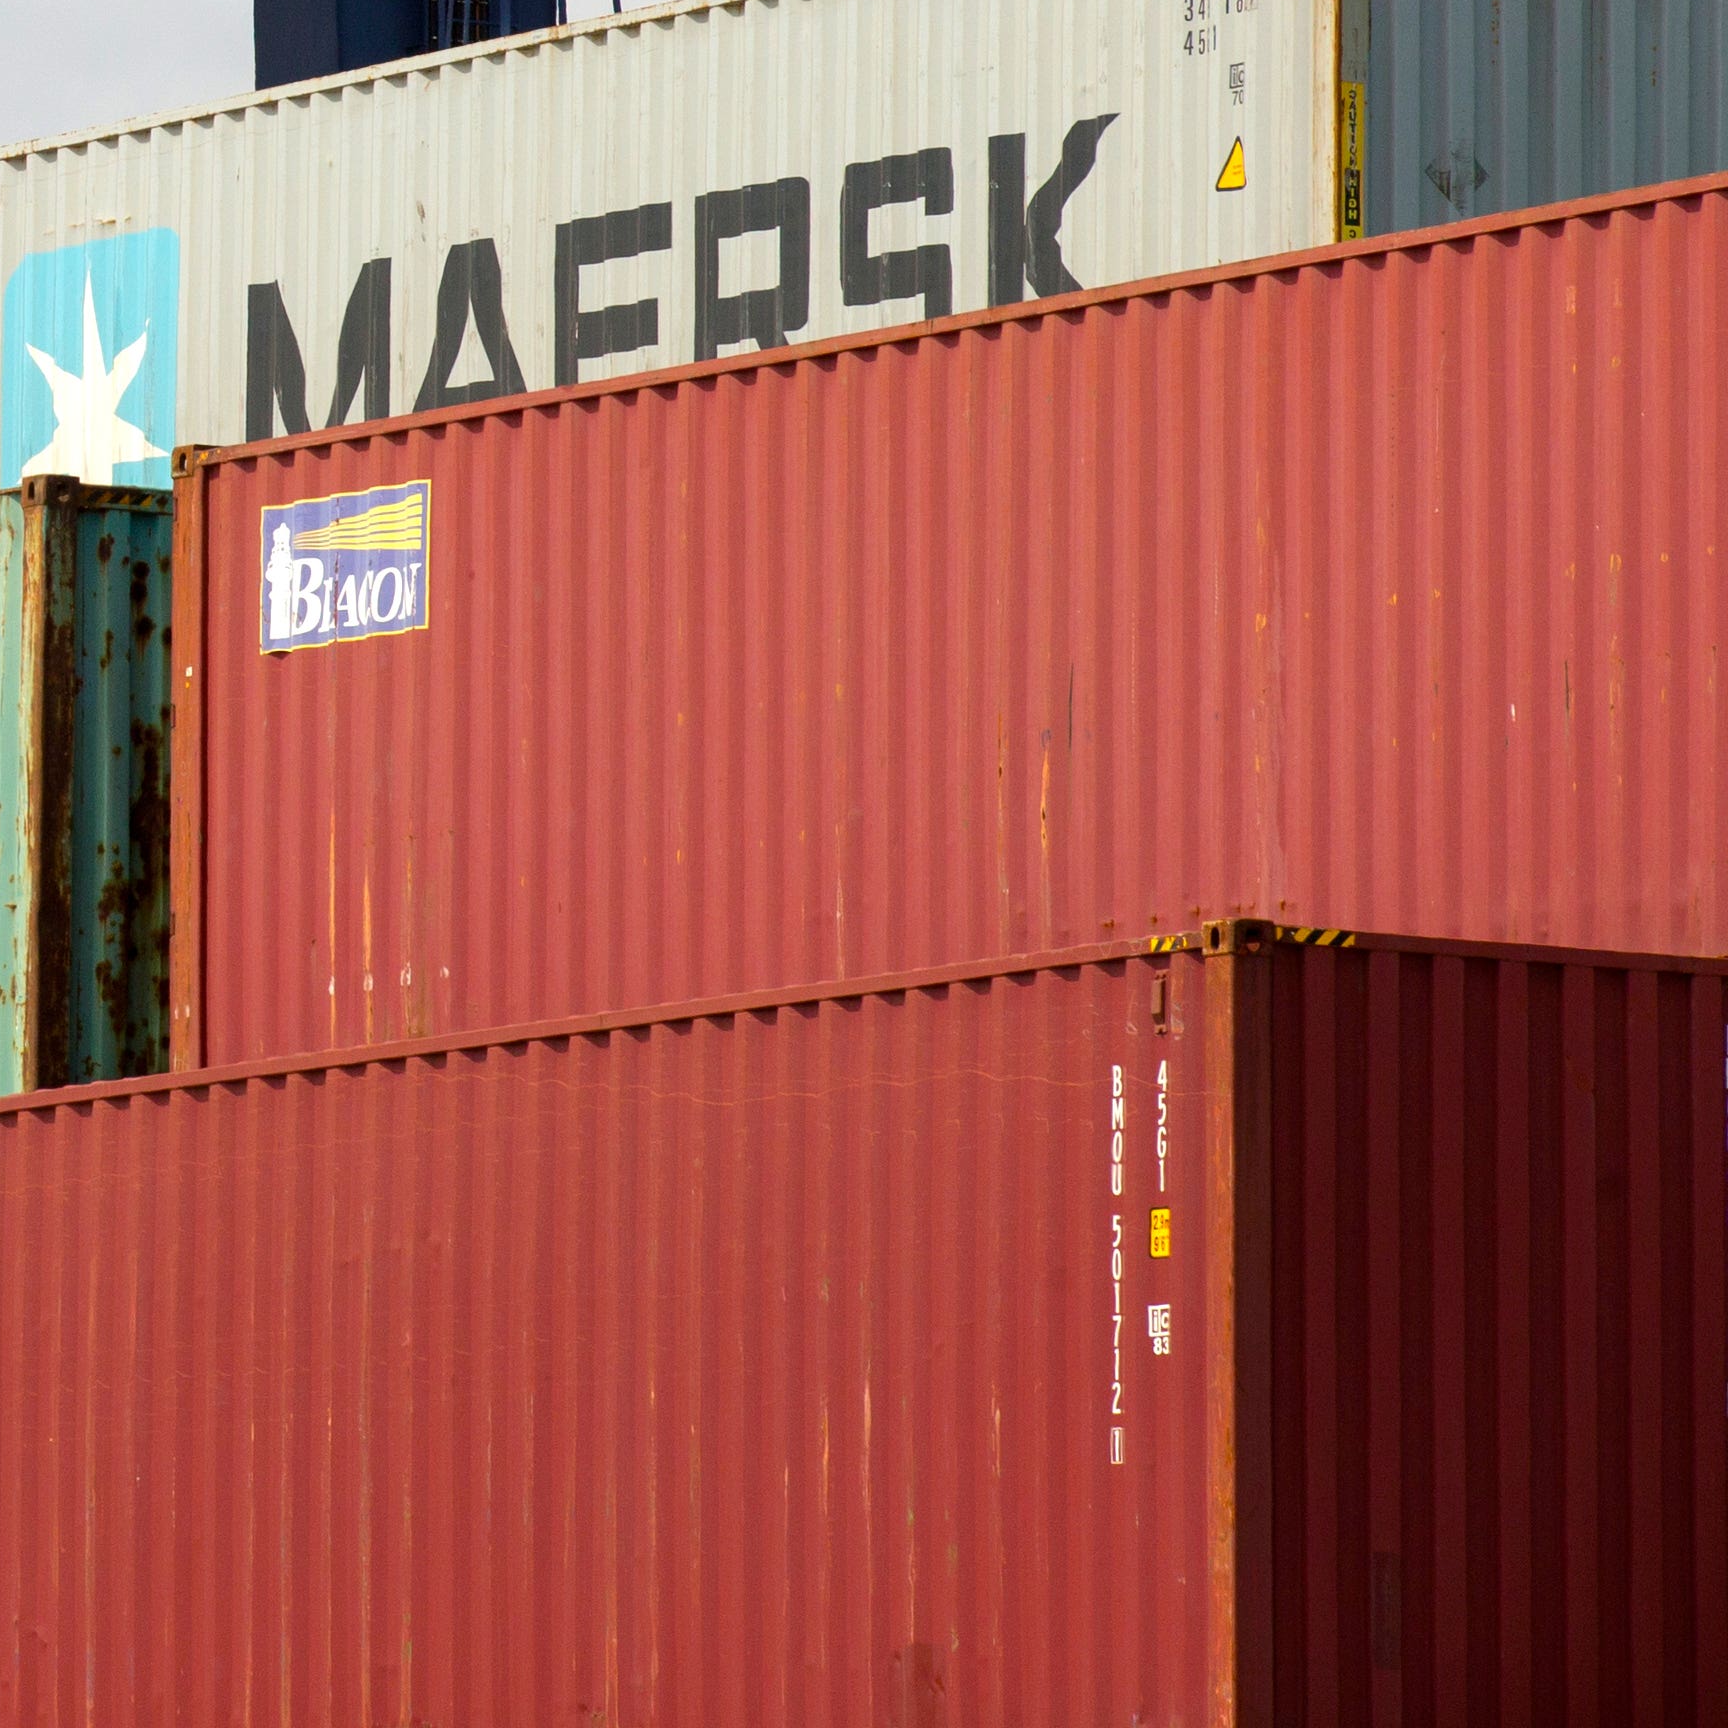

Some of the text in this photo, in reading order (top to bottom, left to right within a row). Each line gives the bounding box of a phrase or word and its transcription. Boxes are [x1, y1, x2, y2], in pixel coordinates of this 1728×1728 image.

[246, 112, 1120, 443] MAERSK
[1157, 1059, 1168, 1193] 45G1
[1111, 1064, 1124, 1463] BMOU 501712 1
[1153, 1337, 1170, 1356] 83
